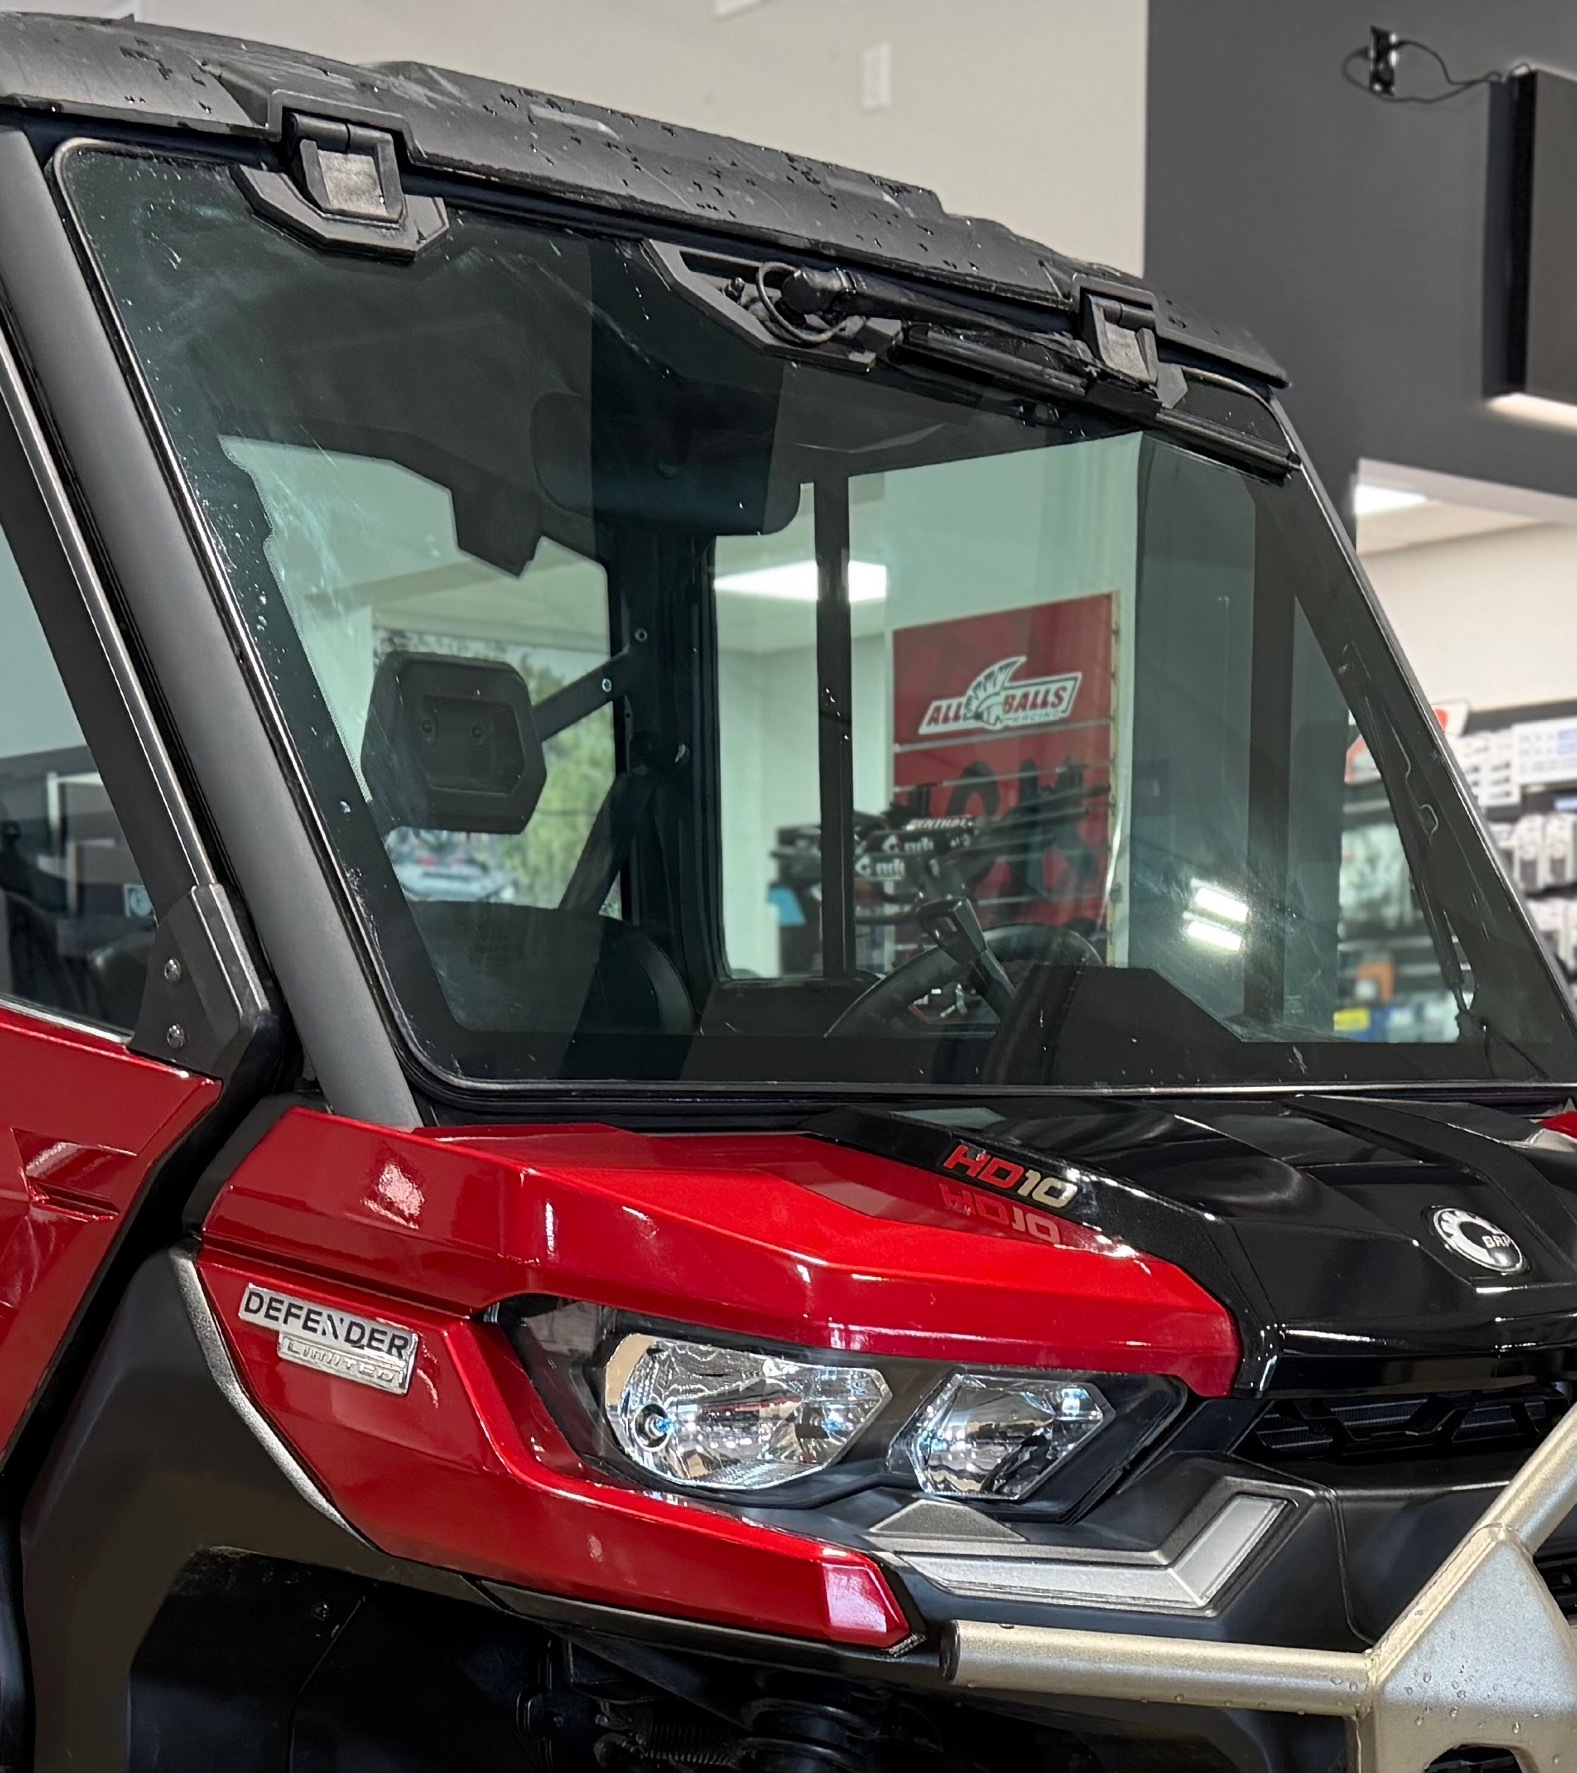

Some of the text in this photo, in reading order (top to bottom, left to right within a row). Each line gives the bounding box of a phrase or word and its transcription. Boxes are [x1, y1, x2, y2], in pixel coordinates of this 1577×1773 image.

[926, 686, 1067, 727] ALL BALLS
[942, 1144, 1078, 1209] HD10
[243, 1290, 410, 1360] DEFENDER
